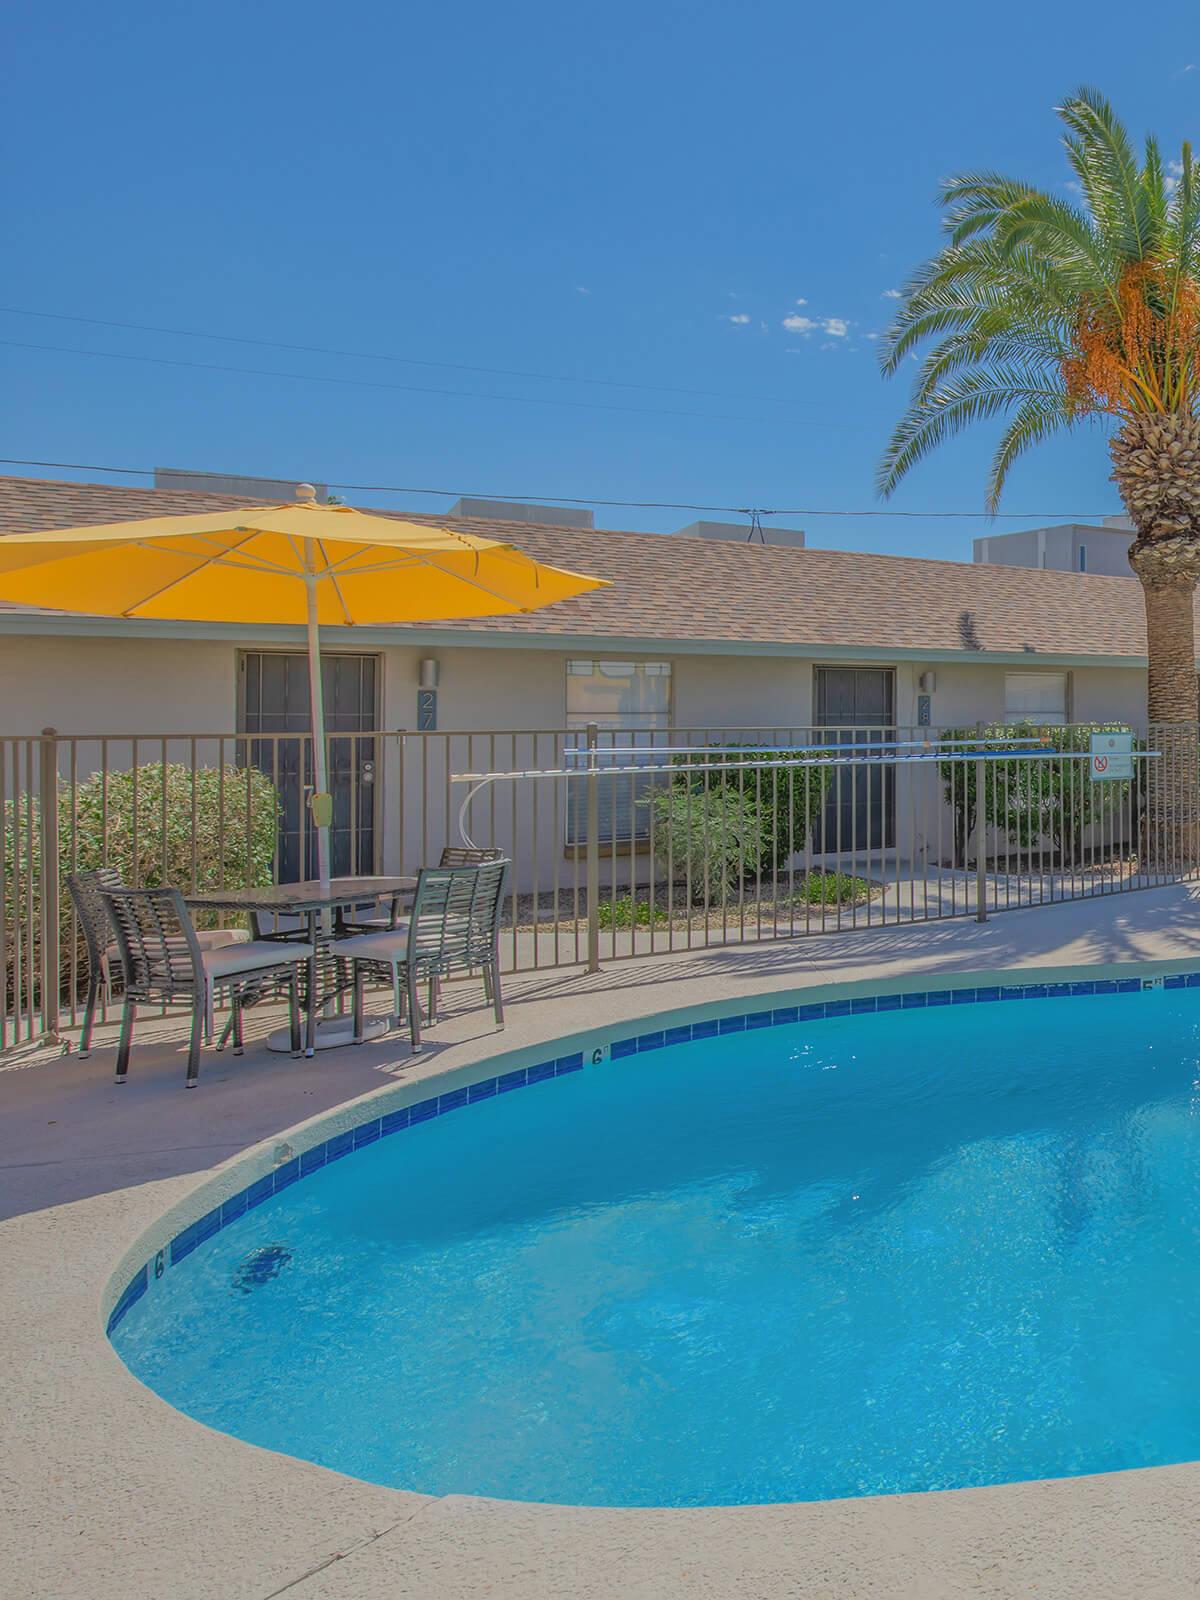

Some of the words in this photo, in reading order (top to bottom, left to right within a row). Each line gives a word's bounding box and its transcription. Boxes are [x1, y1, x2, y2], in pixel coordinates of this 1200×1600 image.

[422, 693, 433, 729] 27
[592, 1048, 602, 1065] 6
[155, 1250, 164, 1280] 6
